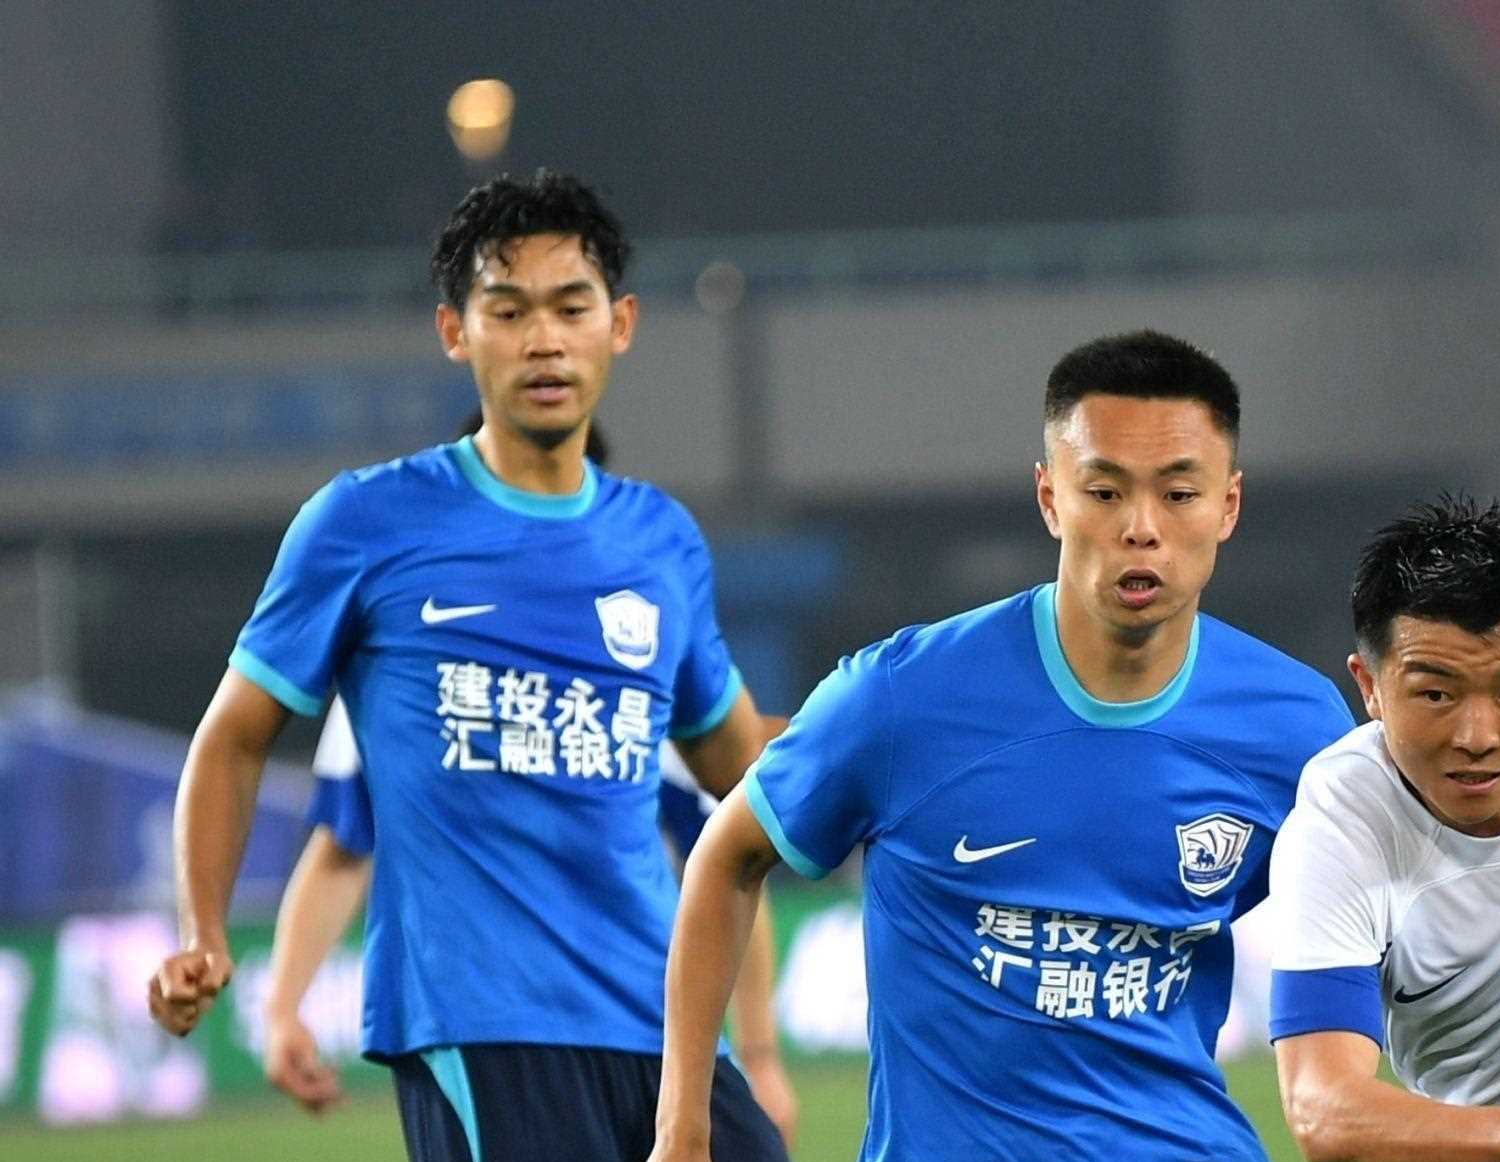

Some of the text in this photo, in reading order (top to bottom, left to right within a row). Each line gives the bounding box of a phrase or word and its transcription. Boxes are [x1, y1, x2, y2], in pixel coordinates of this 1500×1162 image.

[436, 662, 651, 744] 建投永昌
[440, 717, 651, 783] 汇融银行
